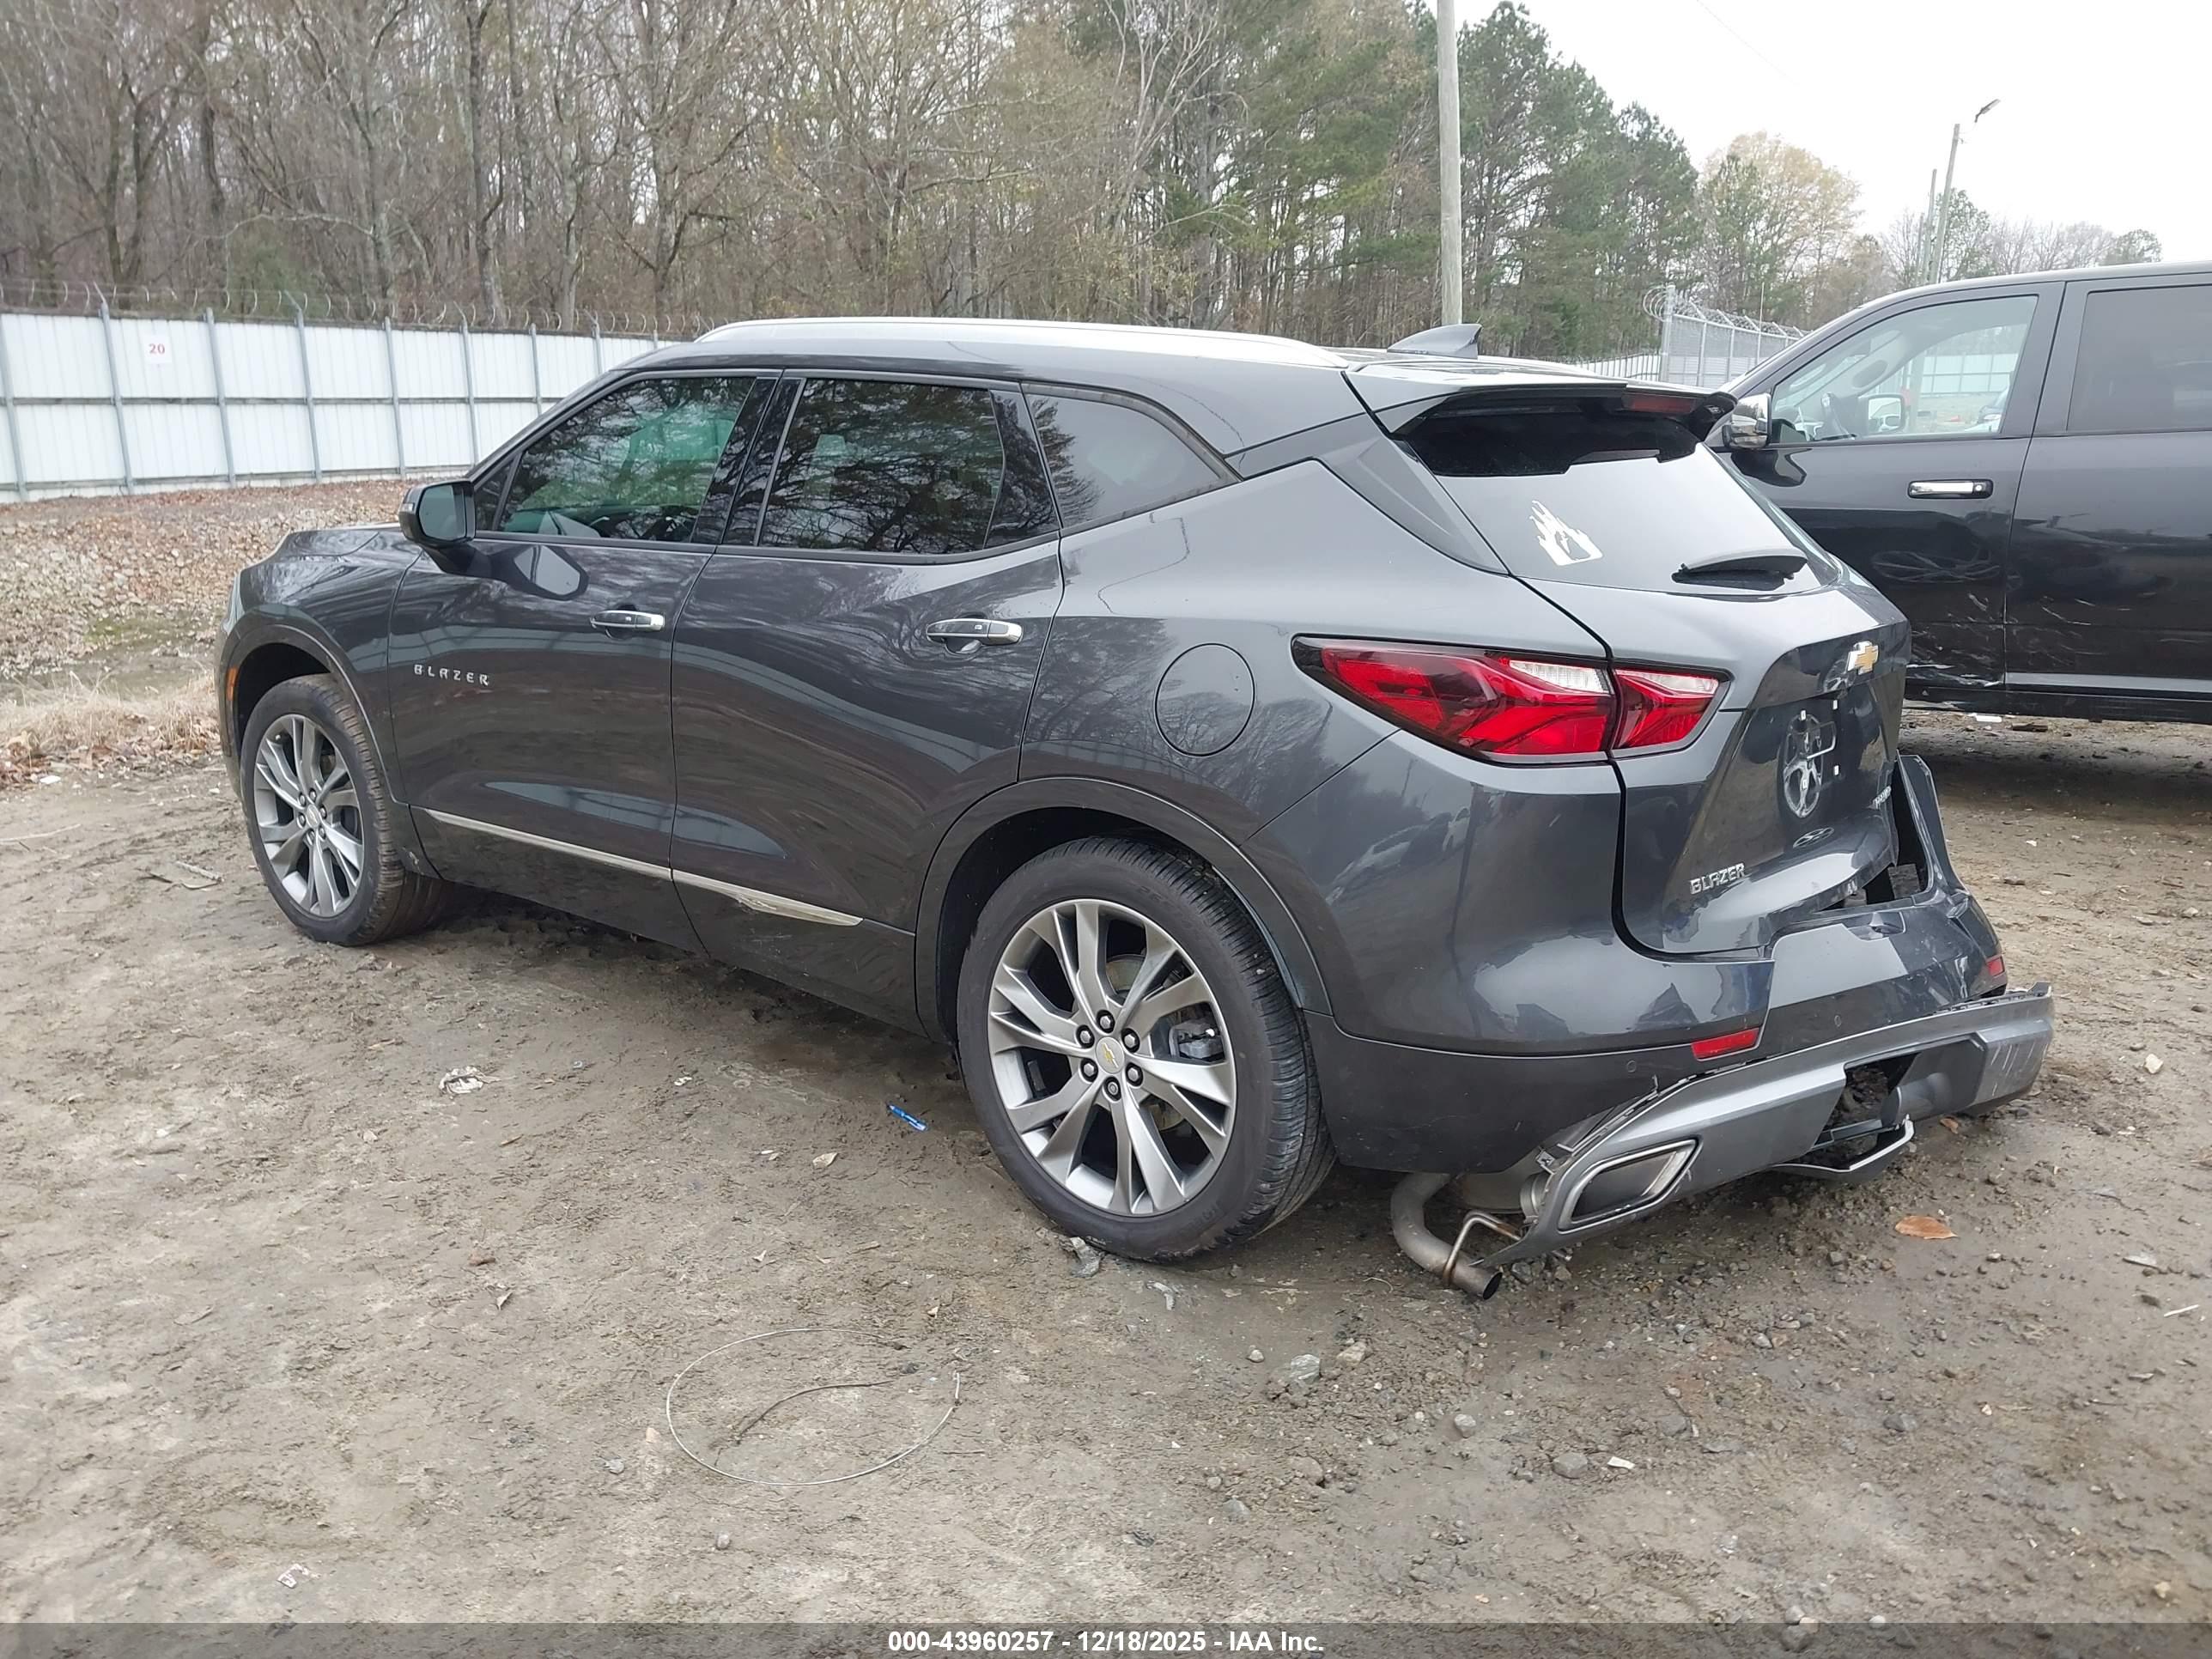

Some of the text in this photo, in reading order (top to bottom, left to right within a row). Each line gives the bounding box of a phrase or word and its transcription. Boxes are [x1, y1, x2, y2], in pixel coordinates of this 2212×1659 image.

[149, 343, 166, 355] 20
[414, 664, 489, 686] BLAZER
[1689, 862, 1746, 895] BLAZER
